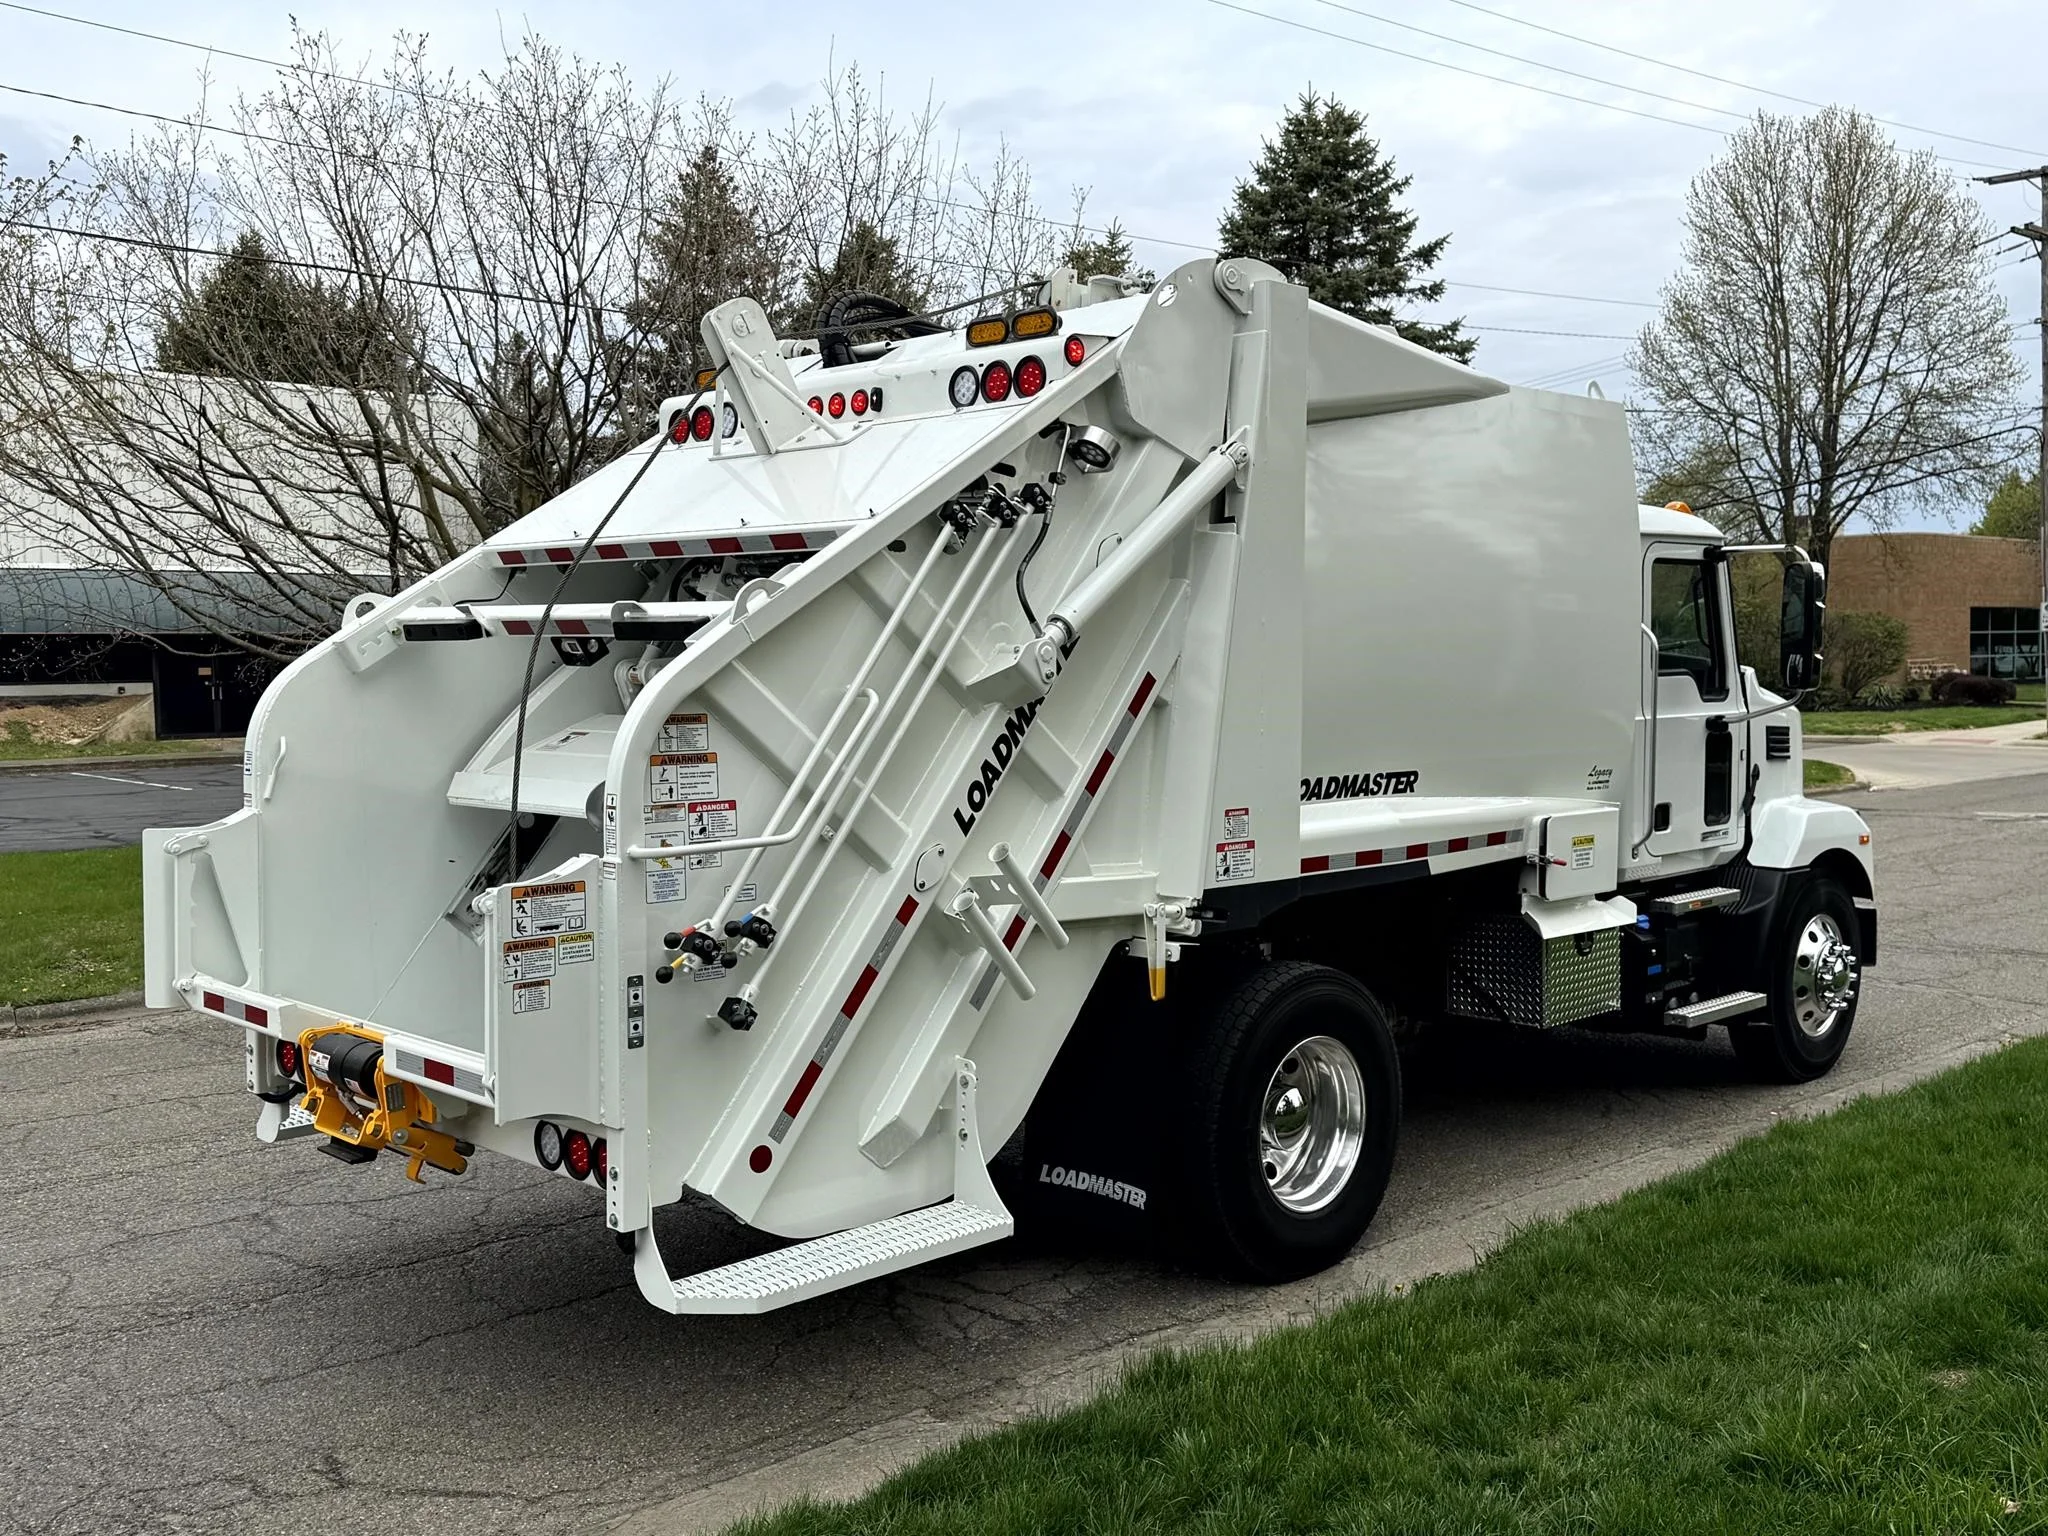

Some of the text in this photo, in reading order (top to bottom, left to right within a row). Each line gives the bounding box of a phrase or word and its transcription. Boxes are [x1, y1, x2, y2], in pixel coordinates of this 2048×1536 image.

[670, 715, 702, 723] WARNING
[667, 755, 708, 765] WARNING
[1588, 765, 1613, 780] Legacy
[1300, 770, 1419, 802] OADMASTER
[702, 803, 730, 811] DANGER
[531, 883, 576, 897] WARNING
[565, 934, 592, 943] CAUTION
[512, 939, 549, 950] WARNING
[1040, 1163, 1147, 1210] LOADMASTER
